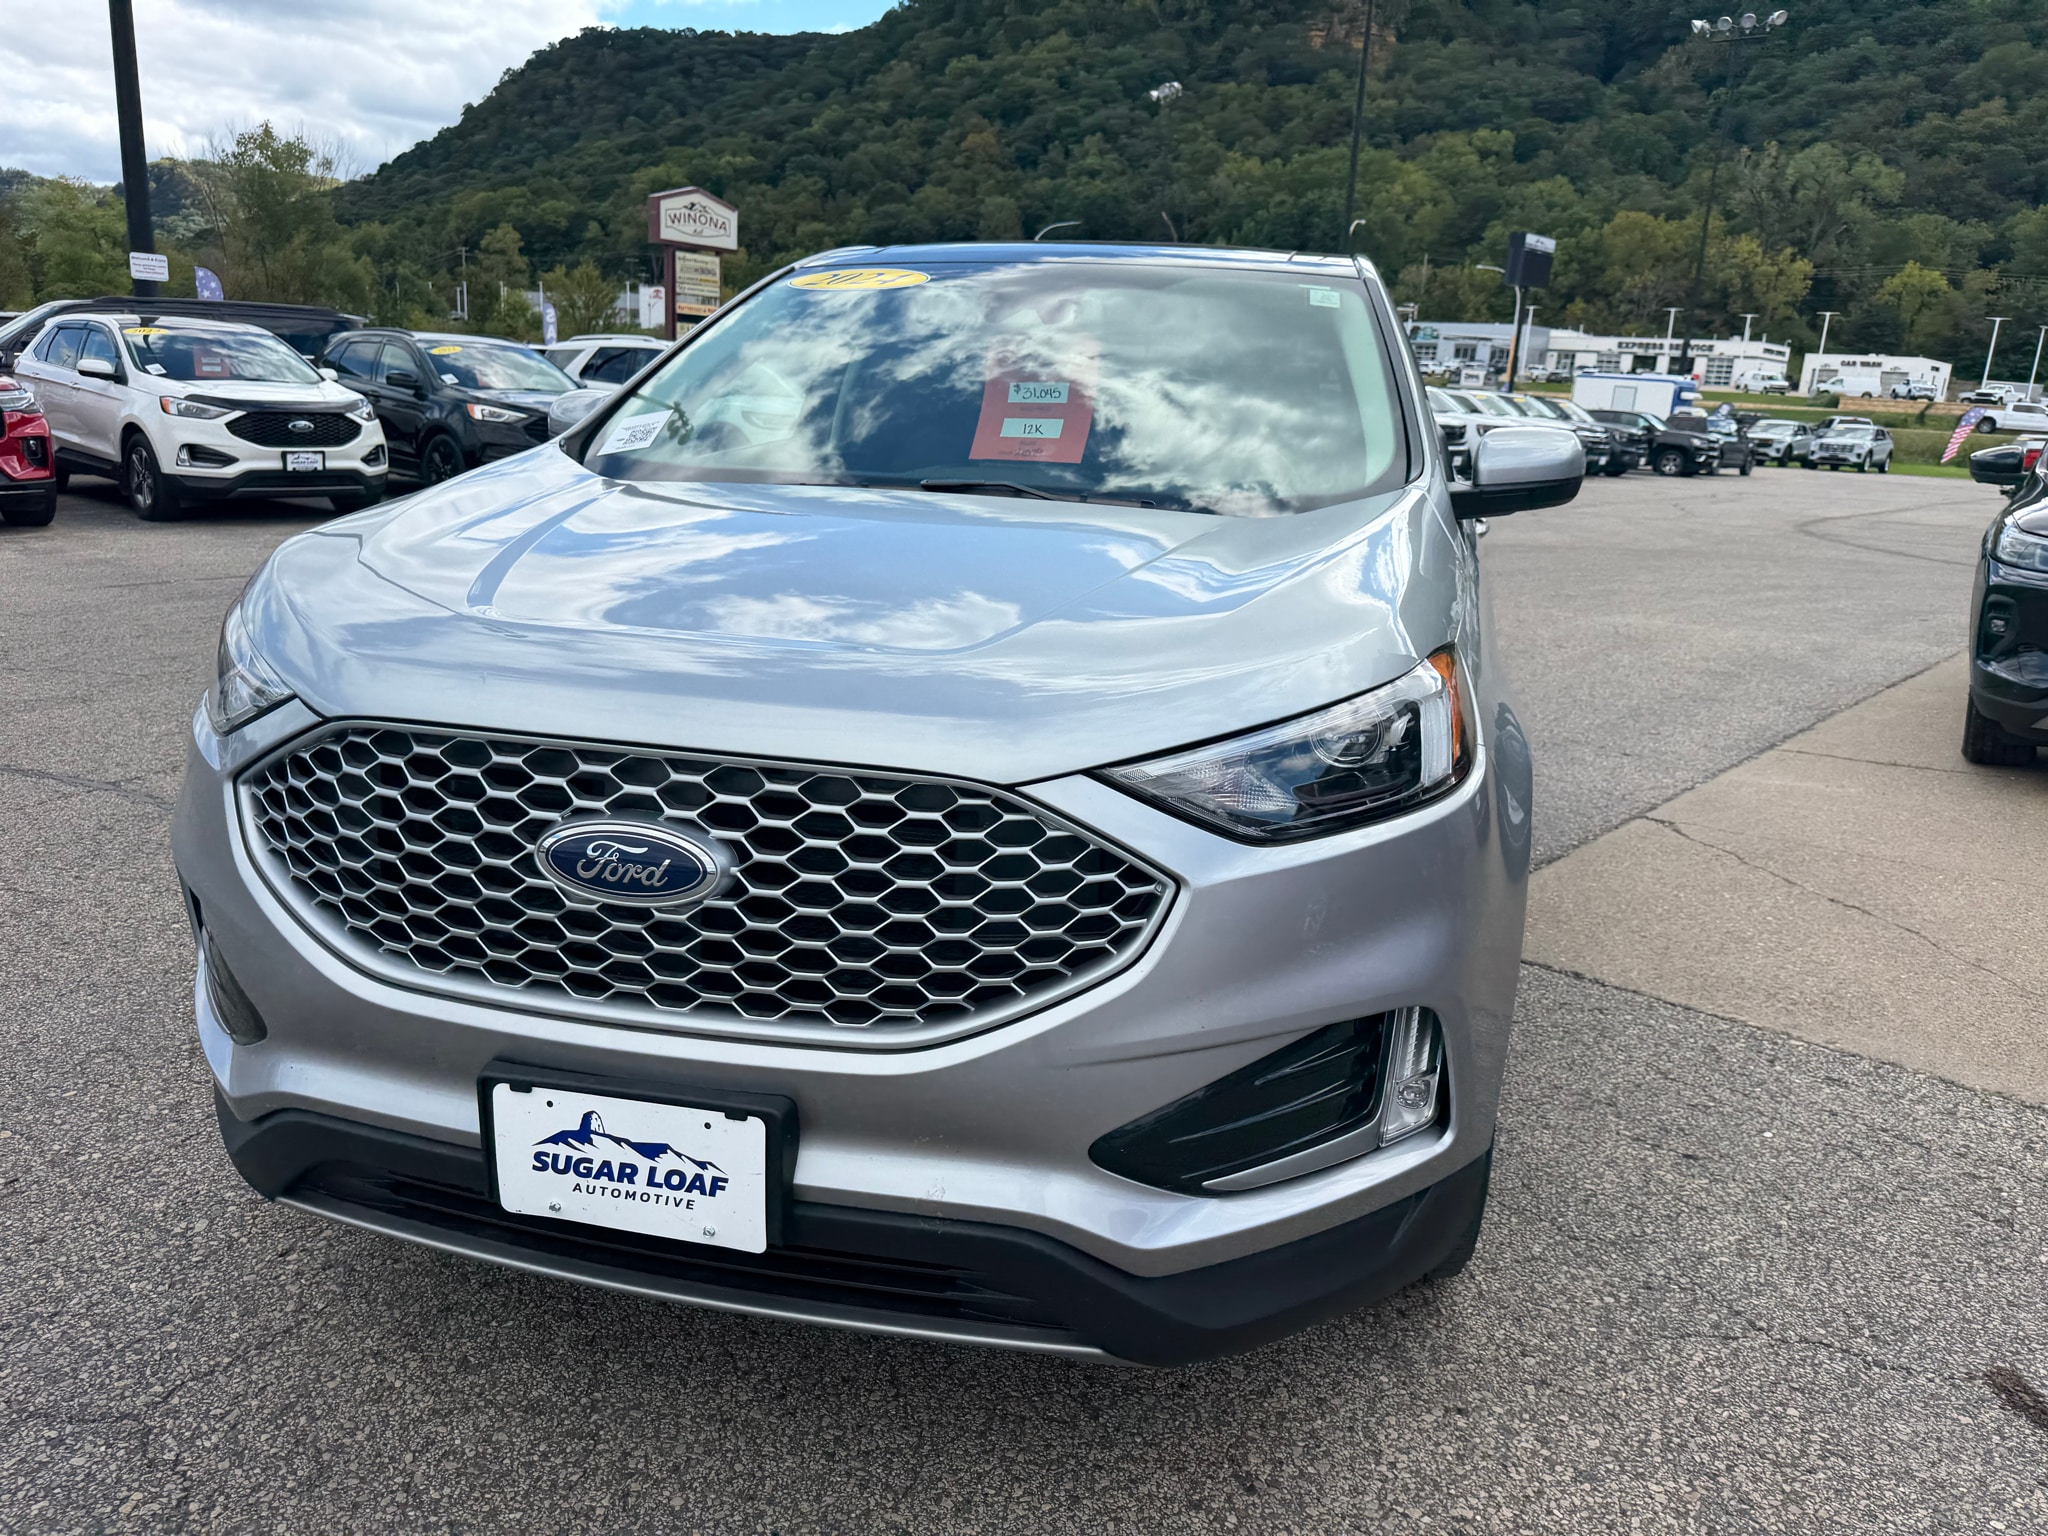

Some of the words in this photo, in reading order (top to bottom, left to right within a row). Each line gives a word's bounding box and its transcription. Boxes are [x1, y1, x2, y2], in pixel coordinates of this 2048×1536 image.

[668, 212, 728, 232] WINONA
[1617, 341, 1664, 350] EXPRESS
[1669, 342, 1715, 352] SEVICE
[1023, 423, 1044, 435] 12K
[576, 840, 672, 887] Ford
[532, 1151, 639, 1185] SUGAR
[646, 1166, 729, 1198] LOAF
[572, 1182, 695, 1210] AUTOMOTIVE
